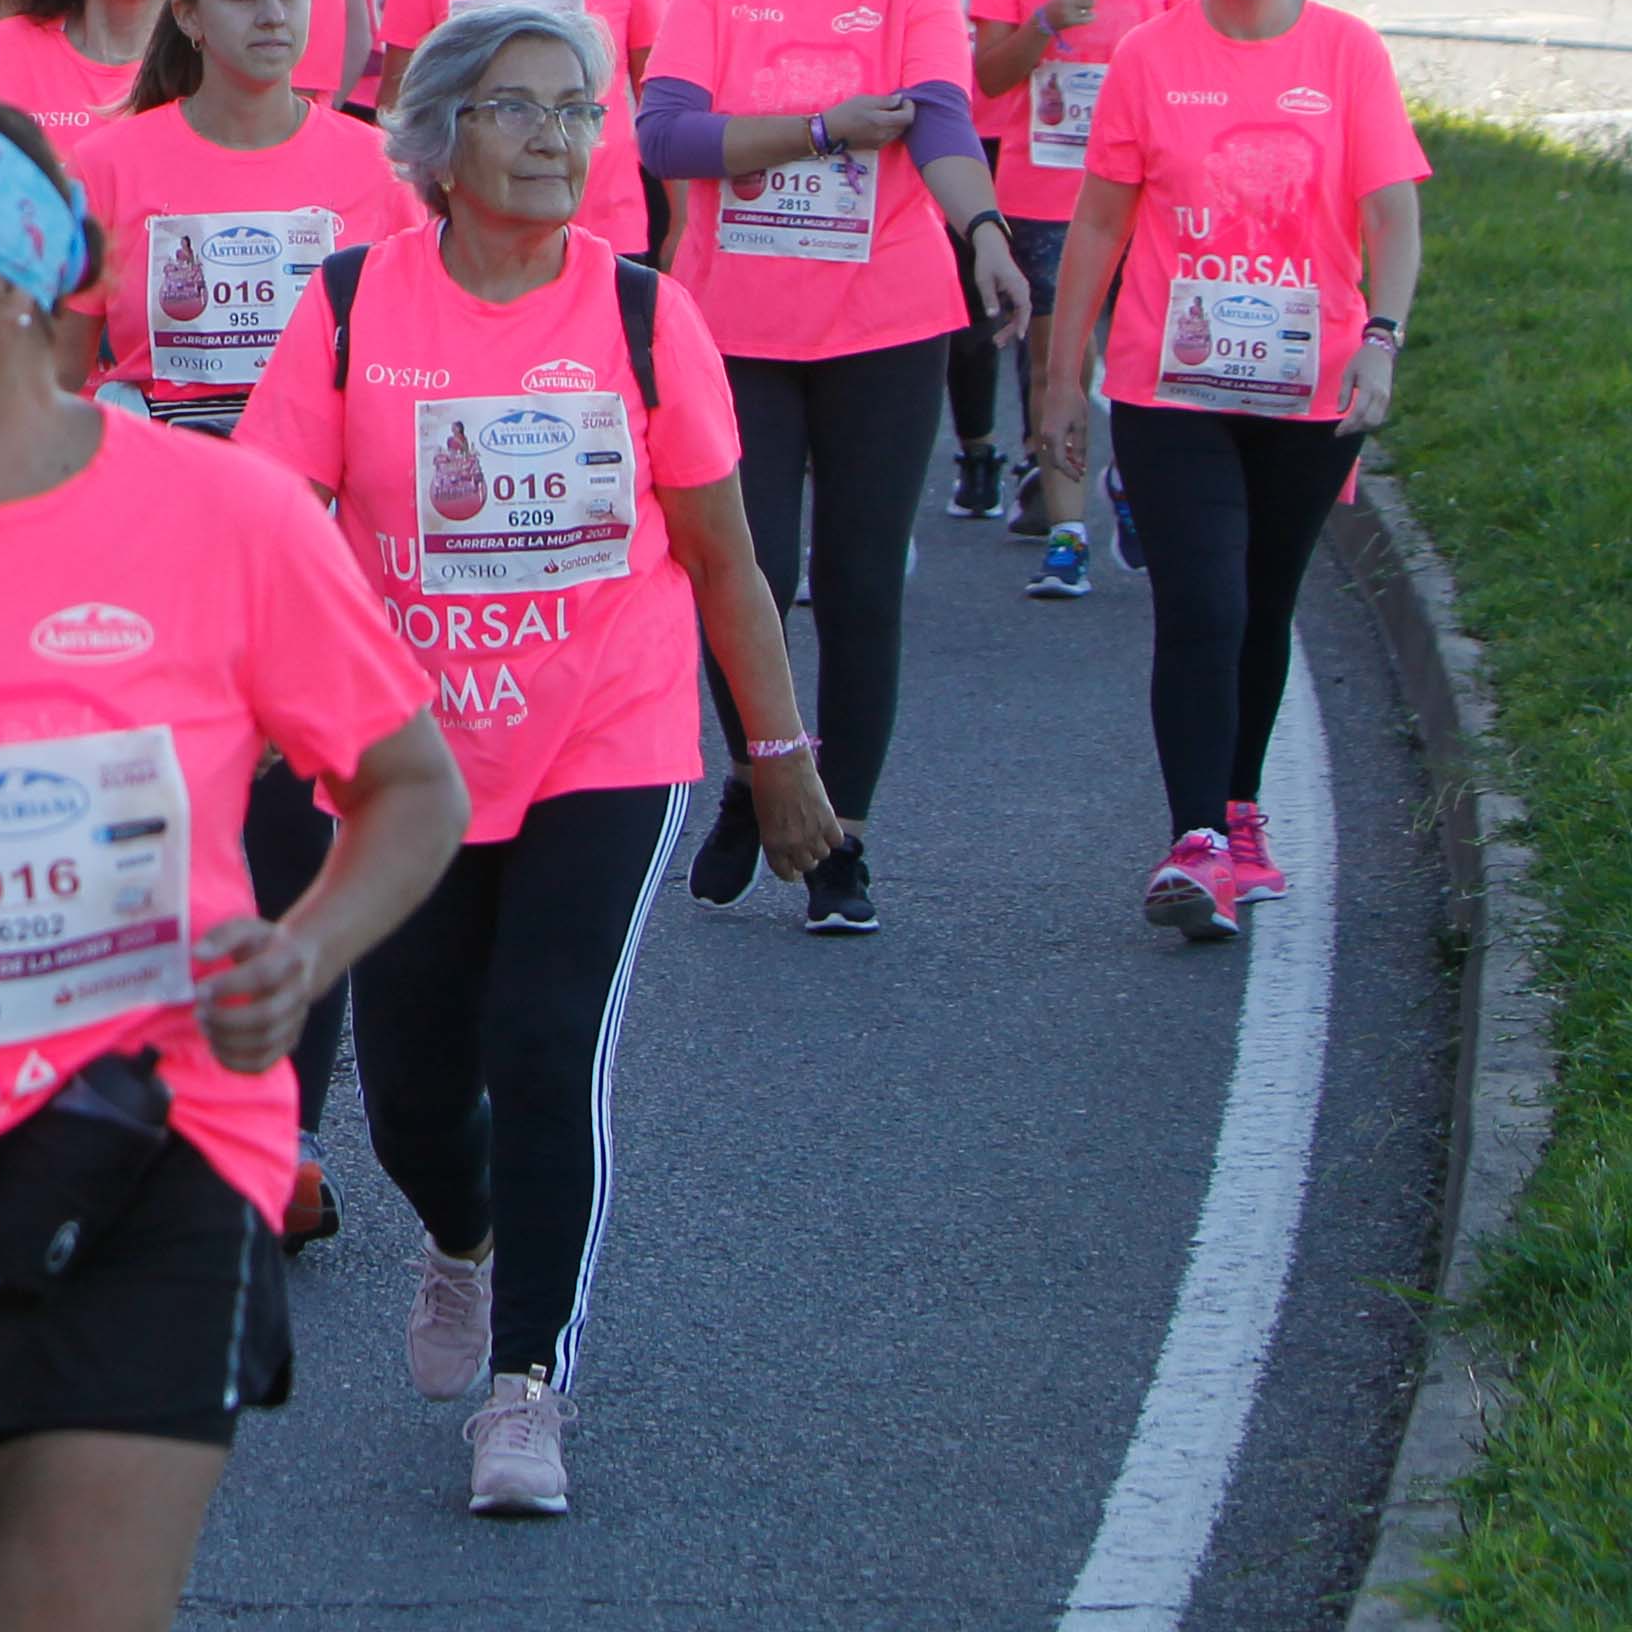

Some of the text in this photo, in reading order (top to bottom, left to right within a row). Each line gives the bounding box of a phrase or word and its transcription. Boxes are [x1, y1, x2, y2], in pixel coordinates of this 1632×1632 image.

[1167, 91, 1228, 106] OYSHO
[1069, 104, 1092, 118] 01
[772, 172, 821, 193] 016
[778, 198, 811, 211] 2813
[1174, 206, 1210, 240] TU
[288, 235, 321, 245] SUMA
[729, 232, 774, 245] OYSHO
[810, 238, 859, 250] Santander
[209, 243, 277, 257] ASTURIANA
[1177, 253, 1317, 288] DORSAL
[213, 280, 274, 304] 016
[230, 312, 259, 326] 955
[1218, 306, 1274, 321] ASTURIANA
[173, 335, 256, 345] CARRERA DE LA
[1216, 338, 1267, 360] 016
[170, 356, 223, 371] OYSHO
[1224, 364, 1256, 377] 2812
[366, 364, 450, 389] OYSHO
[582, 418, 615, 429] SUMA
[487, 429, 568, 446] ASTURIANA
[493, 473, 566, 500] 016
[508, 510, 554, 526] 6209
[446, 528, 612, 549] CARRERA DE LA MUJER 2023
[376, 532, 416, 581] TU
[560, 551, 612, 571] Santander
[442, 563, 507, 580] OYSHO
[384, 597, 570, 650] DORSAL
[45, 624, 144, 648] ASTURIANA
[440, 664, 526, 714] MA
[25, 954, 52, 973] LA
[55, 940, 113, 967] MUJER
